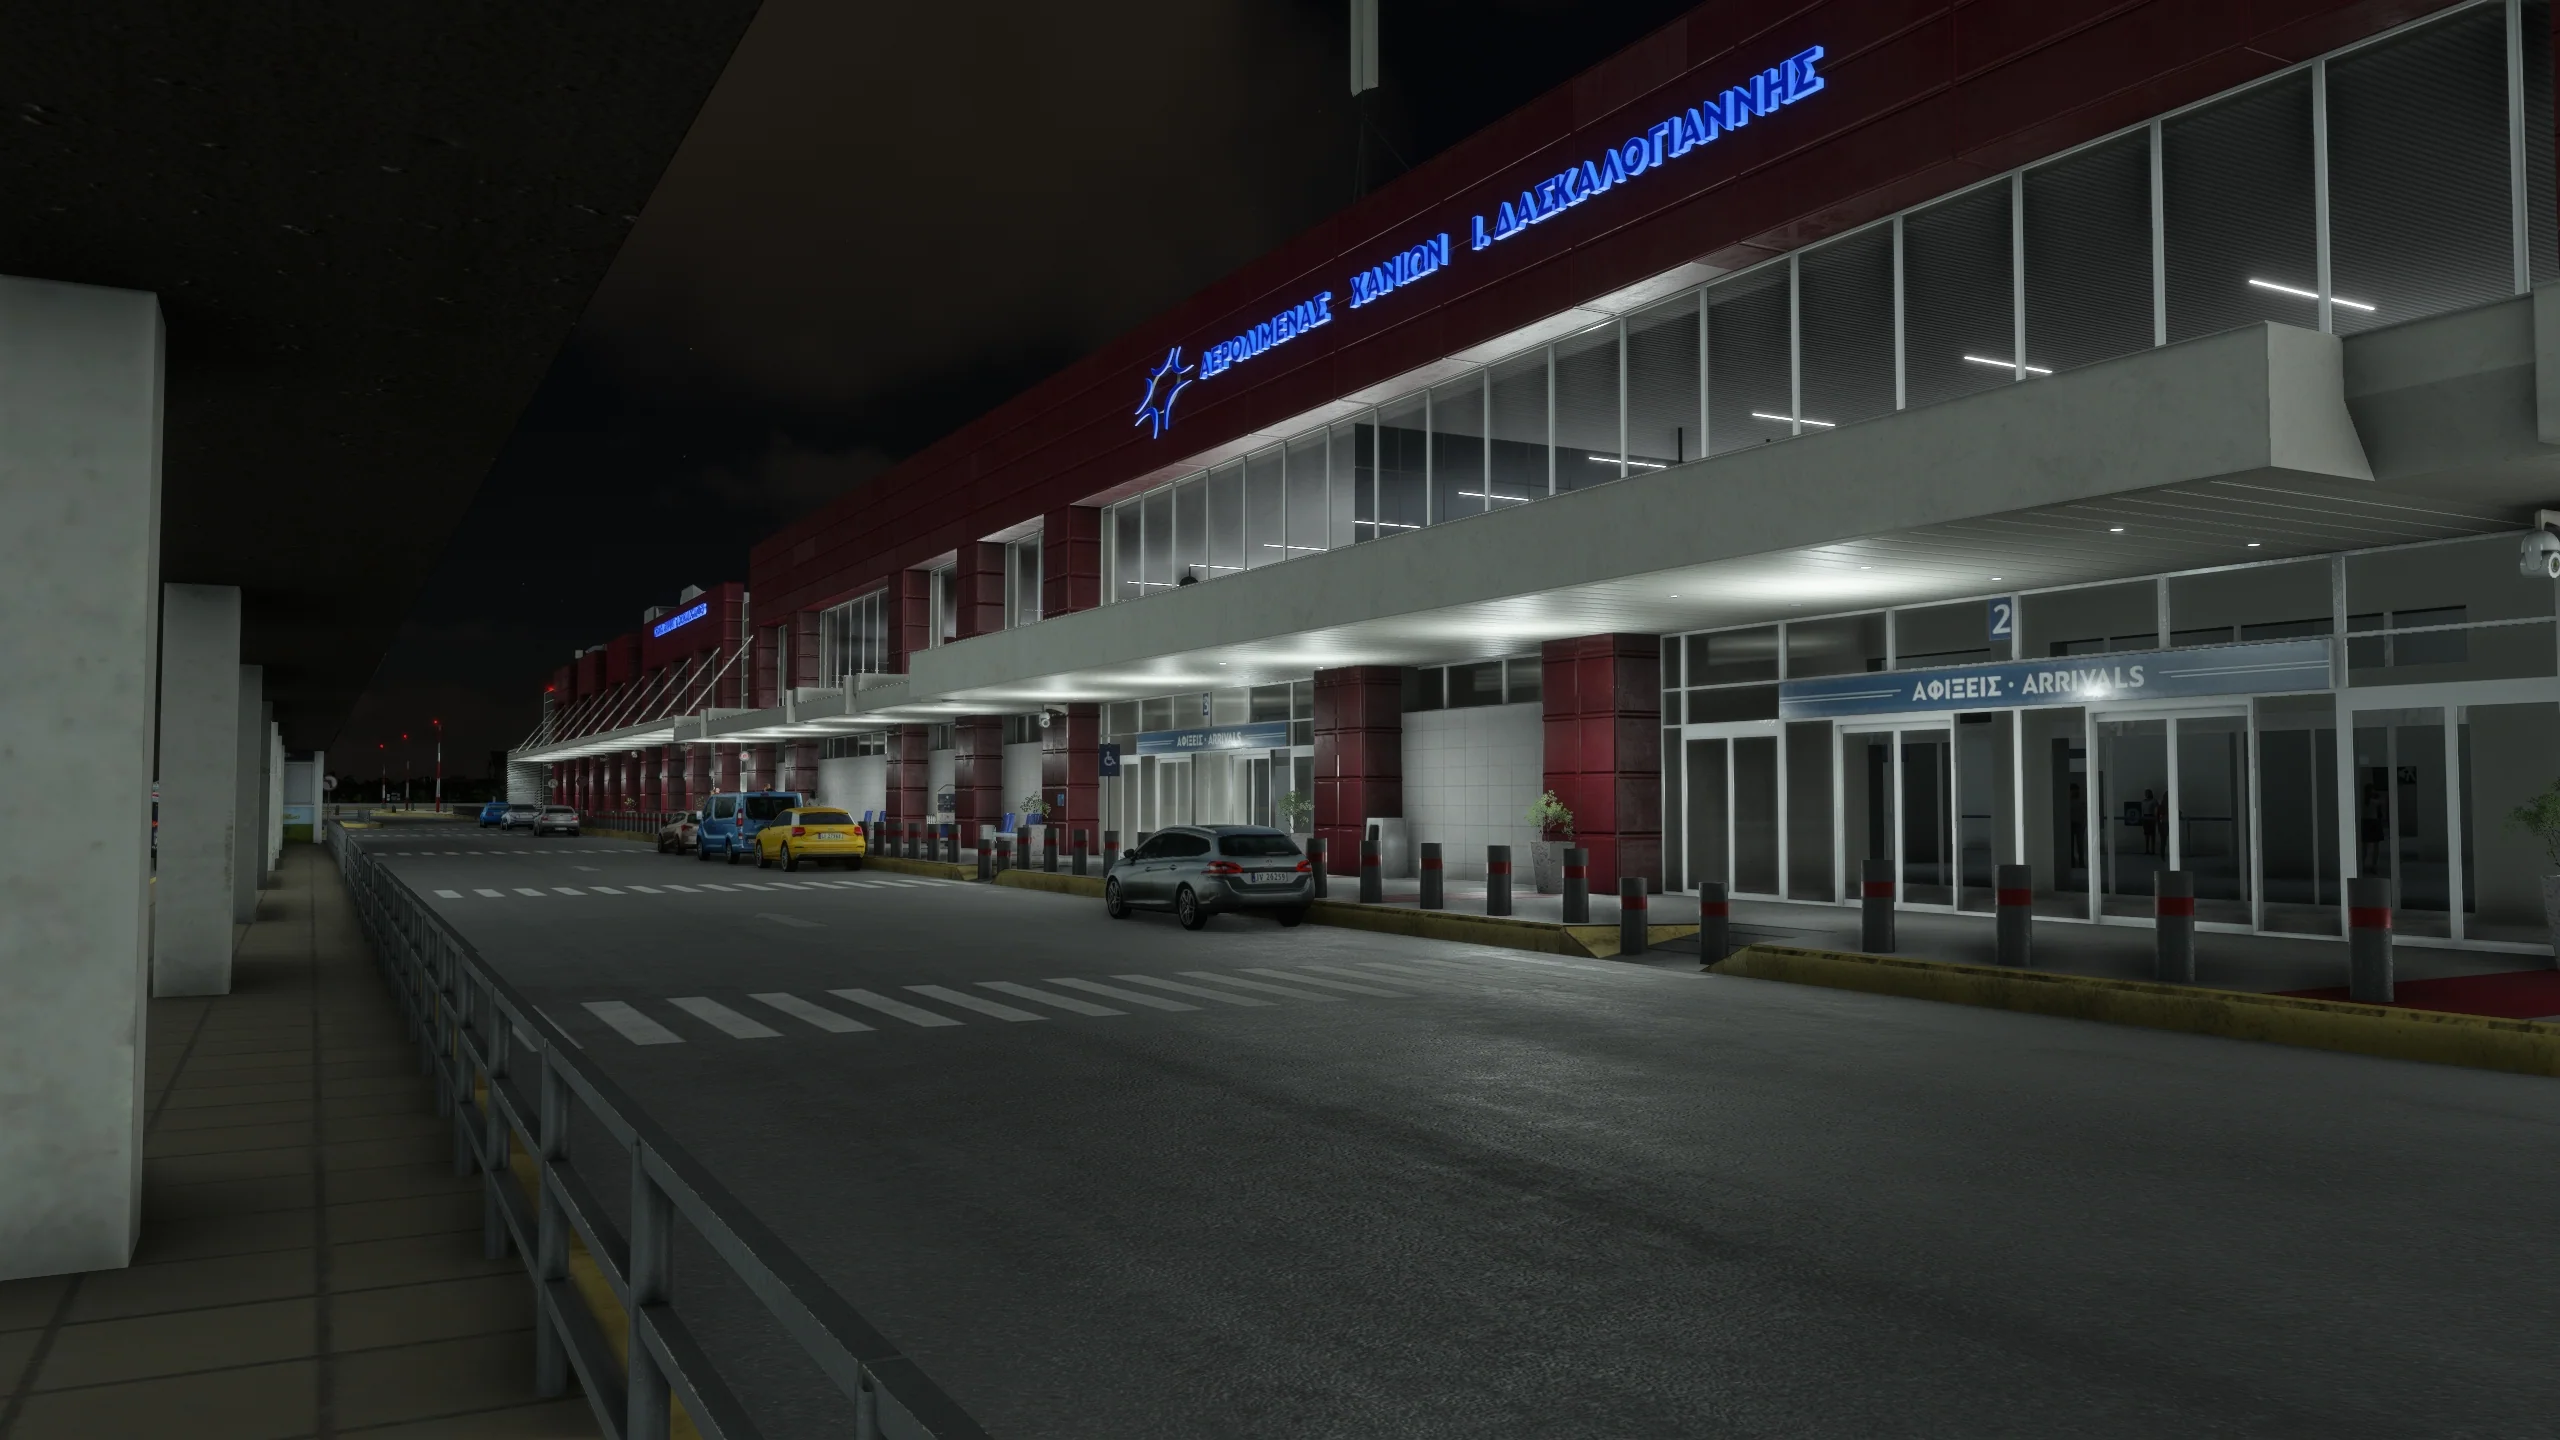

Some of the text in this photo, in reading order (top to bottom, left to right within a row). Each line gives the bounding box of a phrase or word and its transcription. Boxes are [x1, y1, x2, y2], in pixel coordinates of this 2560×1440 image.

[1200, 291, 1332, 379] ΑΕΡΟΛΙΜΕΝΑΣ
[1350, 233, 1449, 308] ΧΑΝΙΩΝ
[1992, 604, 2011, 634] 2
[1912, 665, 2145, 701] ΑΦΙΞΕΙΣ ARRIVALS
[1176, 731, 1242, 747] ΑΦΙΞΕΙΣ ARRIVALS
